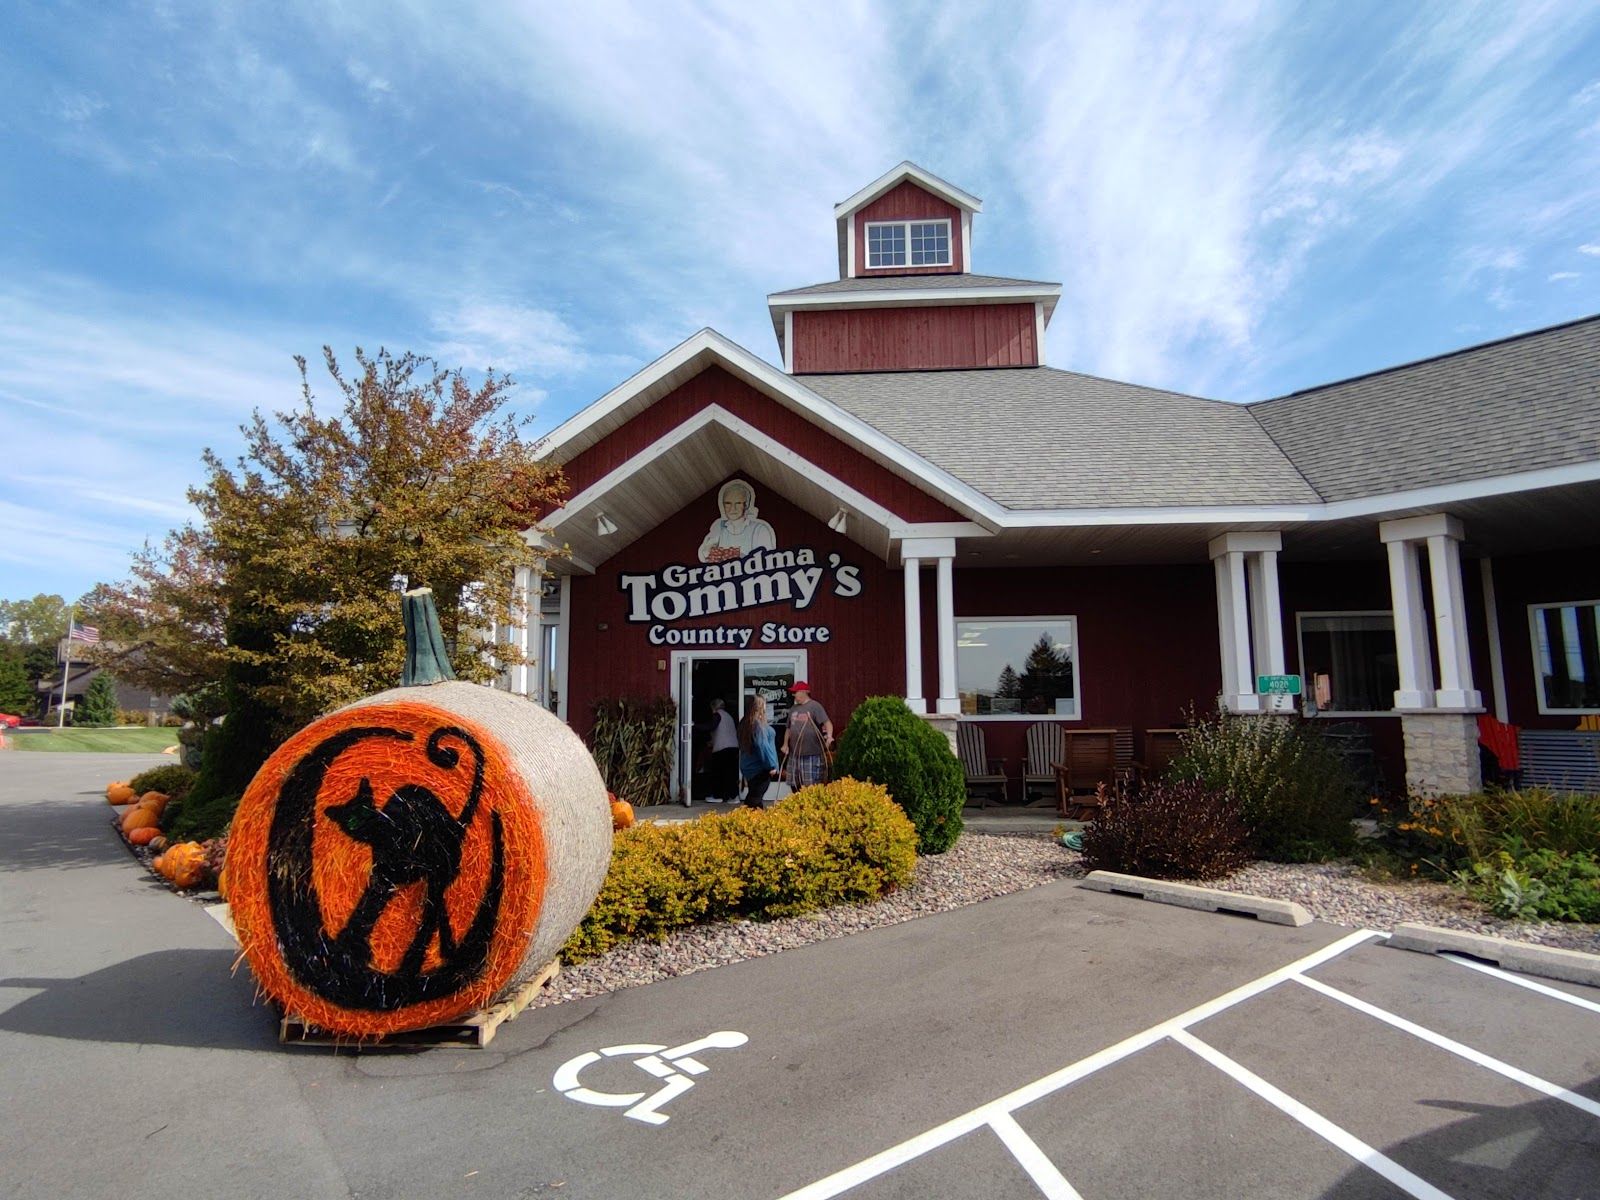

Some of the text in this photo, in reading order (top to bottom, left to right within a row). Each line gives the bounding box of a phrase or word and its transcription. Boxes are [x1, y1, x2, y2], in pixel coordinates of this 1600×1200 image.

[621, 553, 863, 621] Tommy's
[662, 548, 815, 588] Grandma
[649, 622, 830, 648] Country Store
